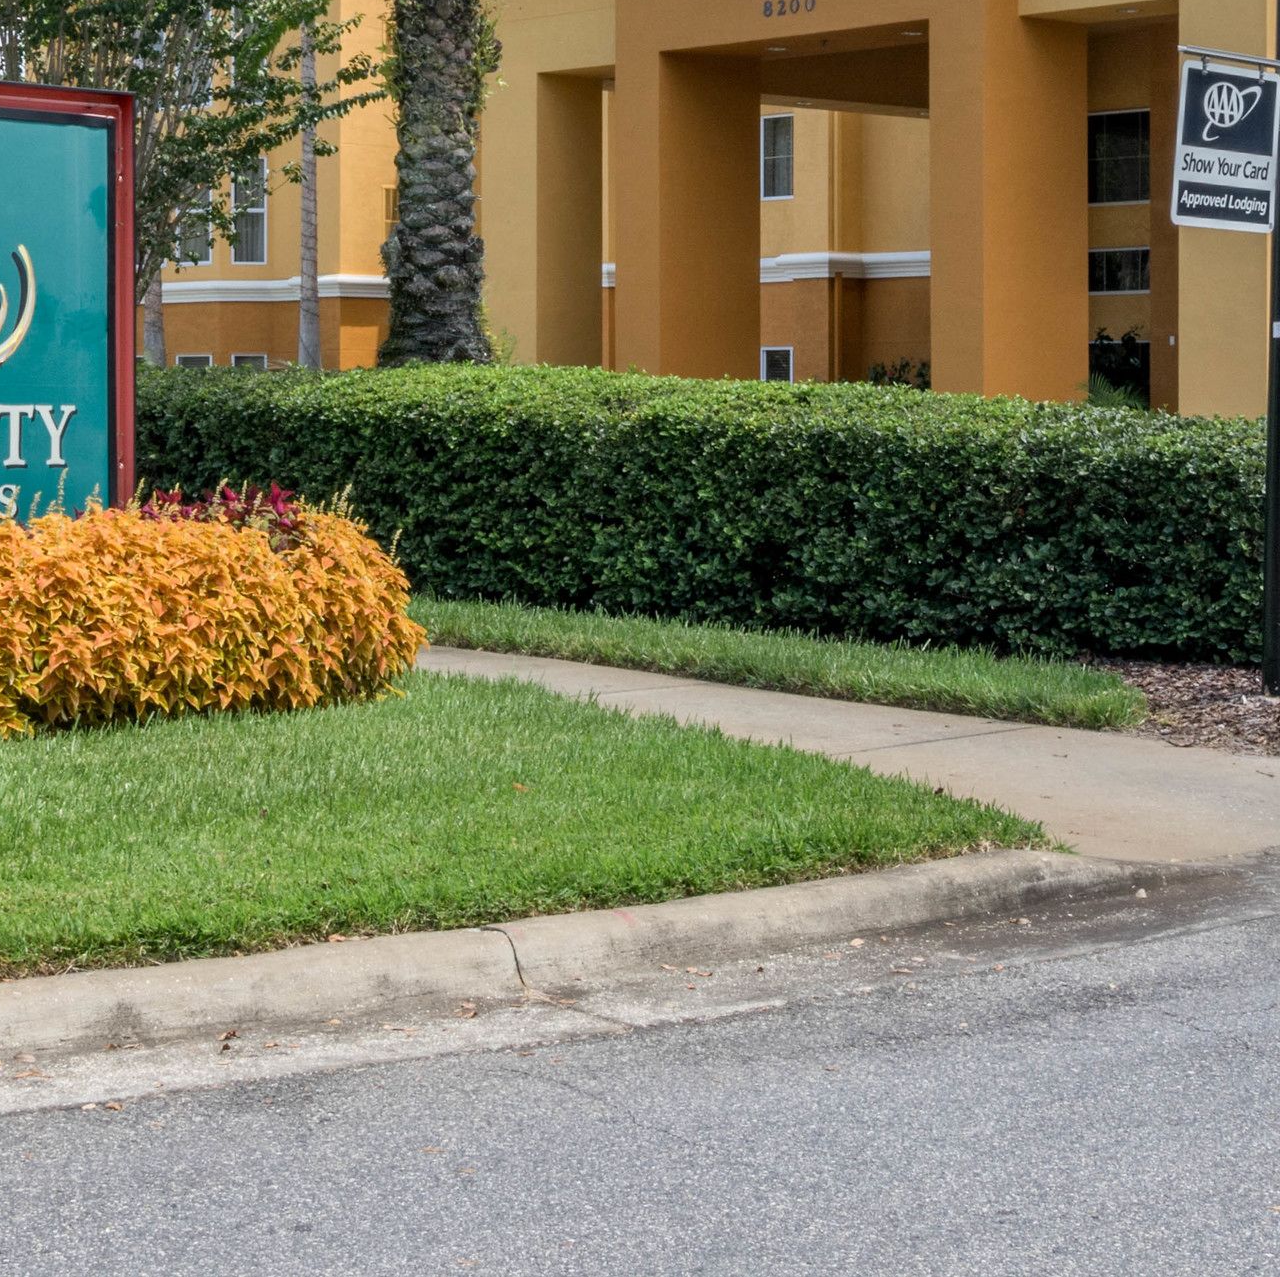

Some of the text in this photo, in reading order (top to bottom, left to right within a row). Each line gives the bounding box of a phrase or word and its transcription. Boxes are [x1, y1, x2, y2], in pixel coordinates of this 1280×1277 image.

[1207, 84, 1241, 126] AAA
[1181, 153, 1270, 180] Show Your Card
[1180, 189, 1268, 215] Approved Lodging
